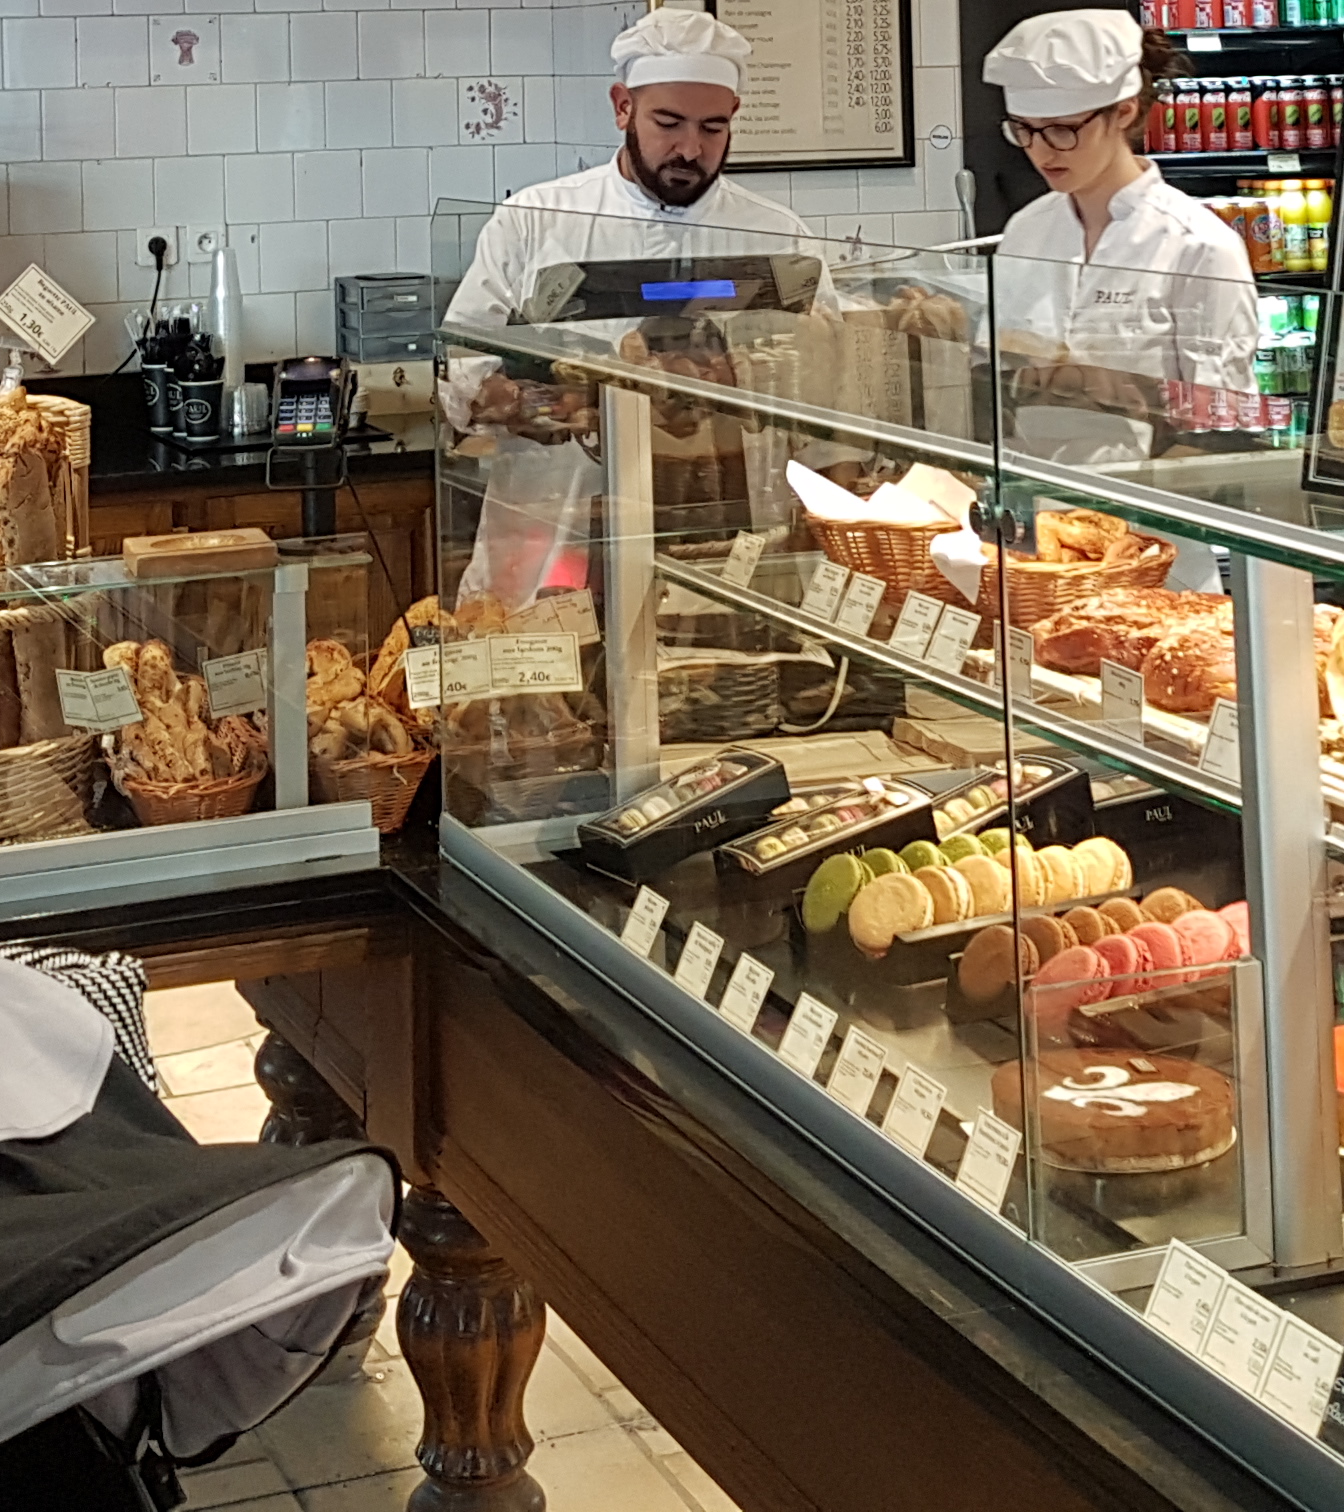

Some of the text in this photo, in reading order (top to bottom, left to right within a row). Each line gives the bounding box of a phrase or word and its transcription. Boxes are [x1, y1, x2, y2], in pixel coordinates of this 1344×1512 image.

[1094, 290, 1133, 304] PAUL
[60, 300, 77, 316] PAUL
[20, 313, 44, 338] 1,30€
[518, 672, 551, 685] 2,40€
[444, 682, 467, 694] ,40€
[694, 810, 727, 834] PAUL
[1145, 806, 1172, 822] PAUL
